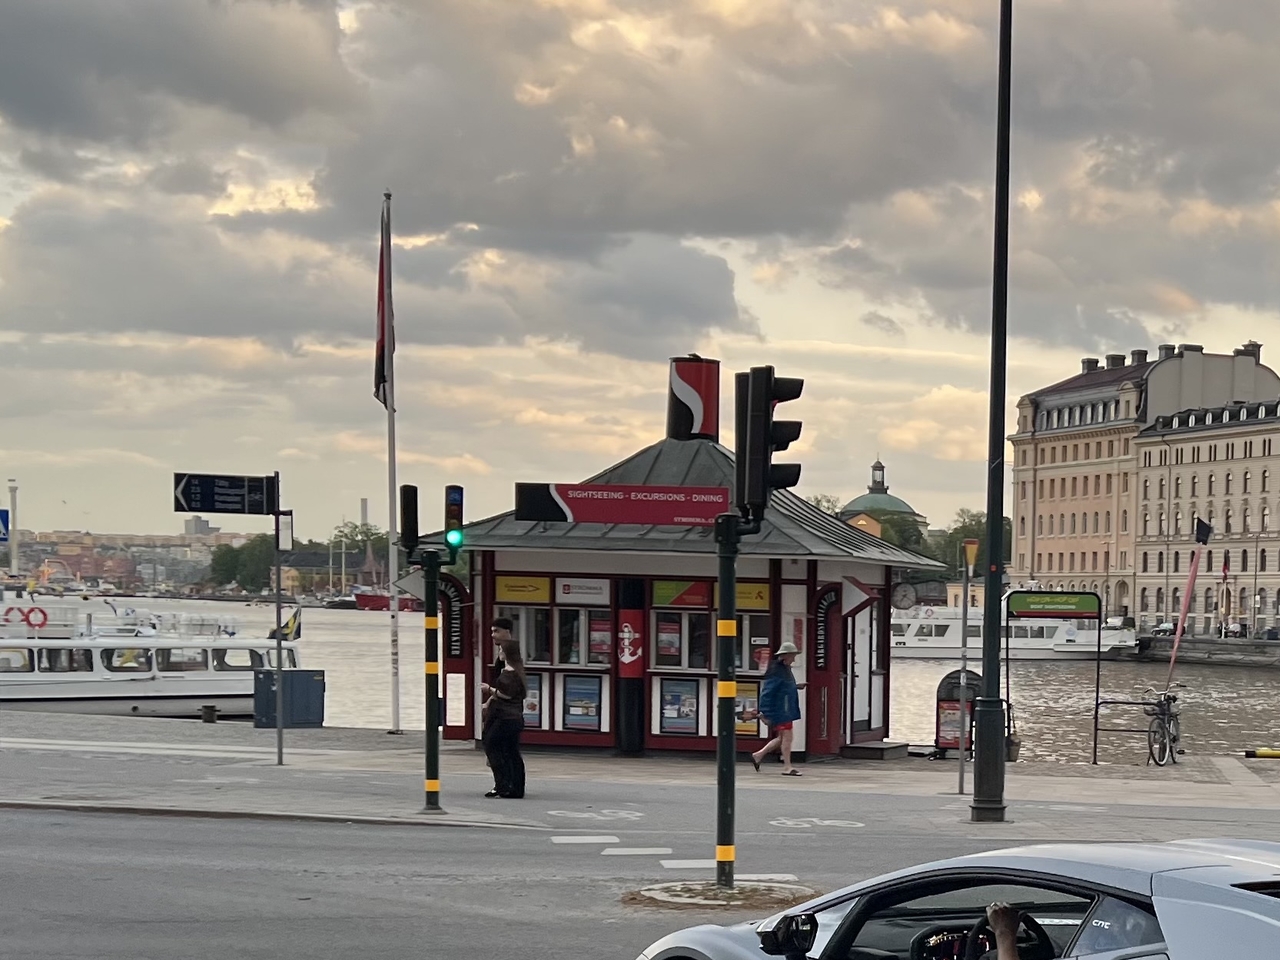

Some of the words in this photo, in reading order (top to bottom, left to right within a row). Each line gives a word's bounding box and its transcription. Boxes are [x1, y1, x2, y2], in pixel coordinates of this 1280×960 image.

[567, 490, 624, 499] SIGHTSEEING
[630, 492, 685, 501] EXCURSIONS
[692, 494, 723, 503] DINING
